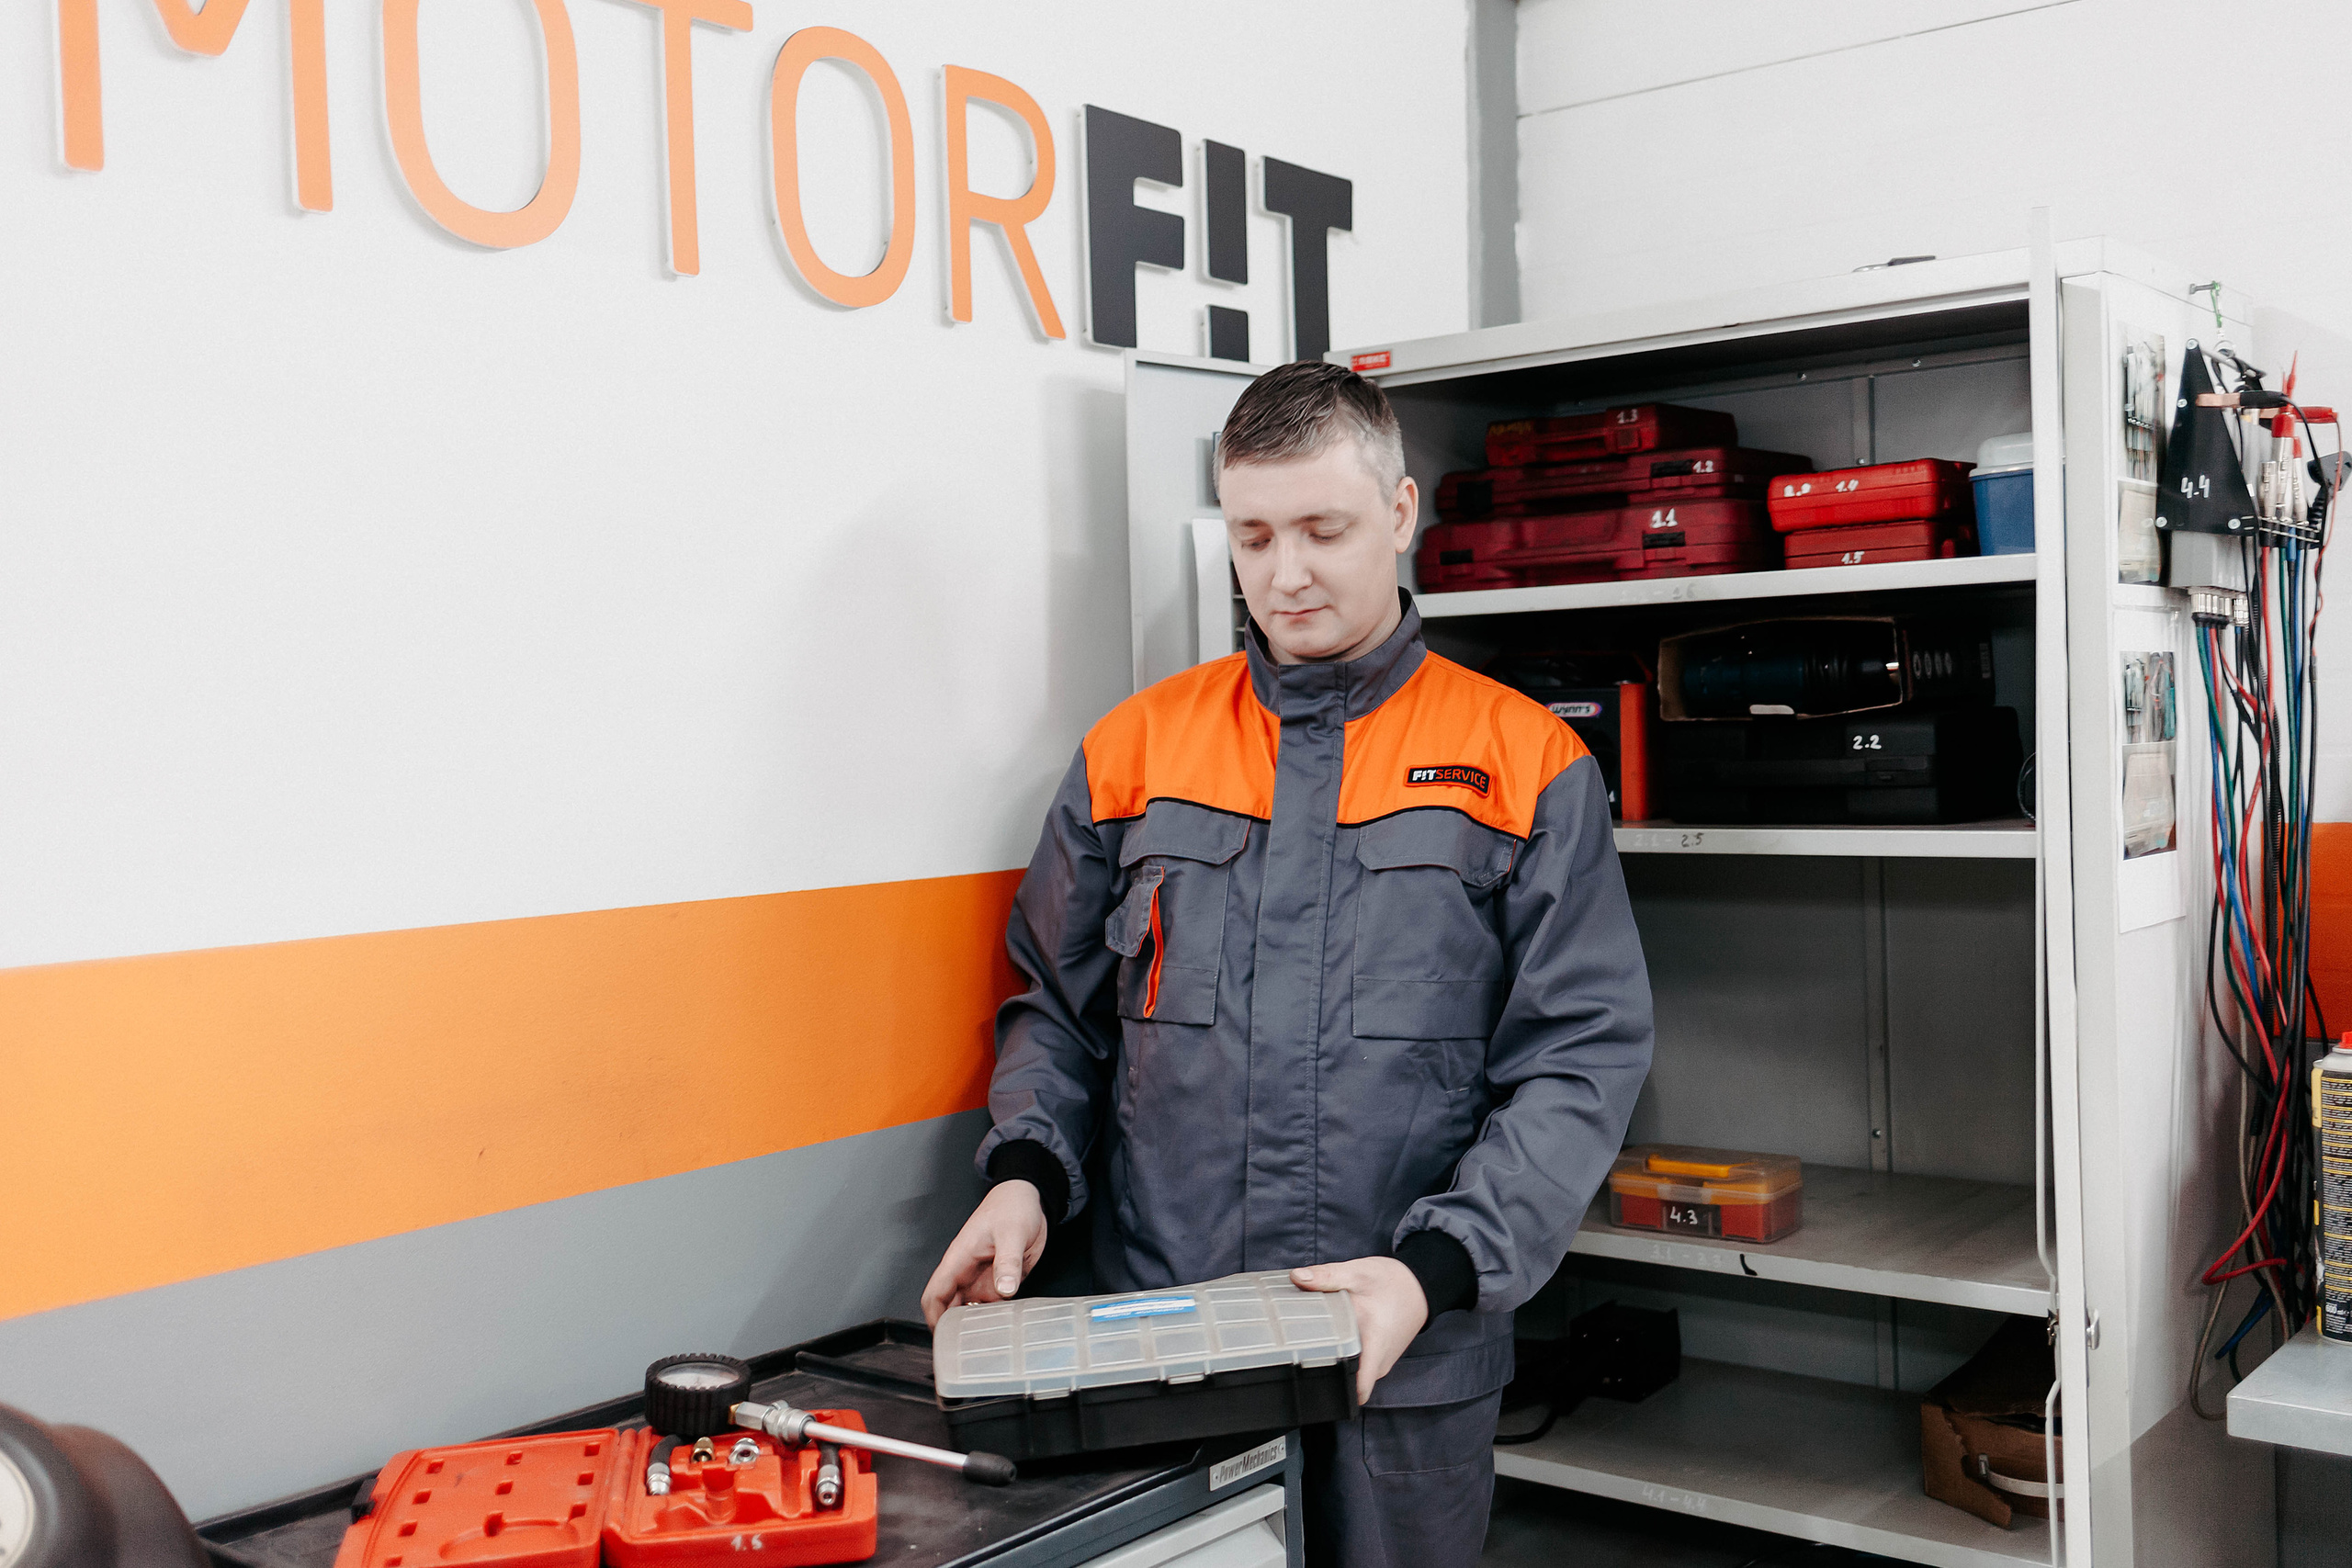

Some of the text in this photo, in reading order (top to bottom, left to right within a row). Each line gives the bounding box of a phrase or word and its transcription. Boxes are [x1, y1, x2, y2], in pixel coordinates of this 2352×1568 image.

[1852, 734, 1883, 750] 2.2
[1680, 831, 1705, 848] 2.5
[1669, 1206, 1699, 1225] 4.3
[1219, 1445, 1278, 1483] PowerMechanics
